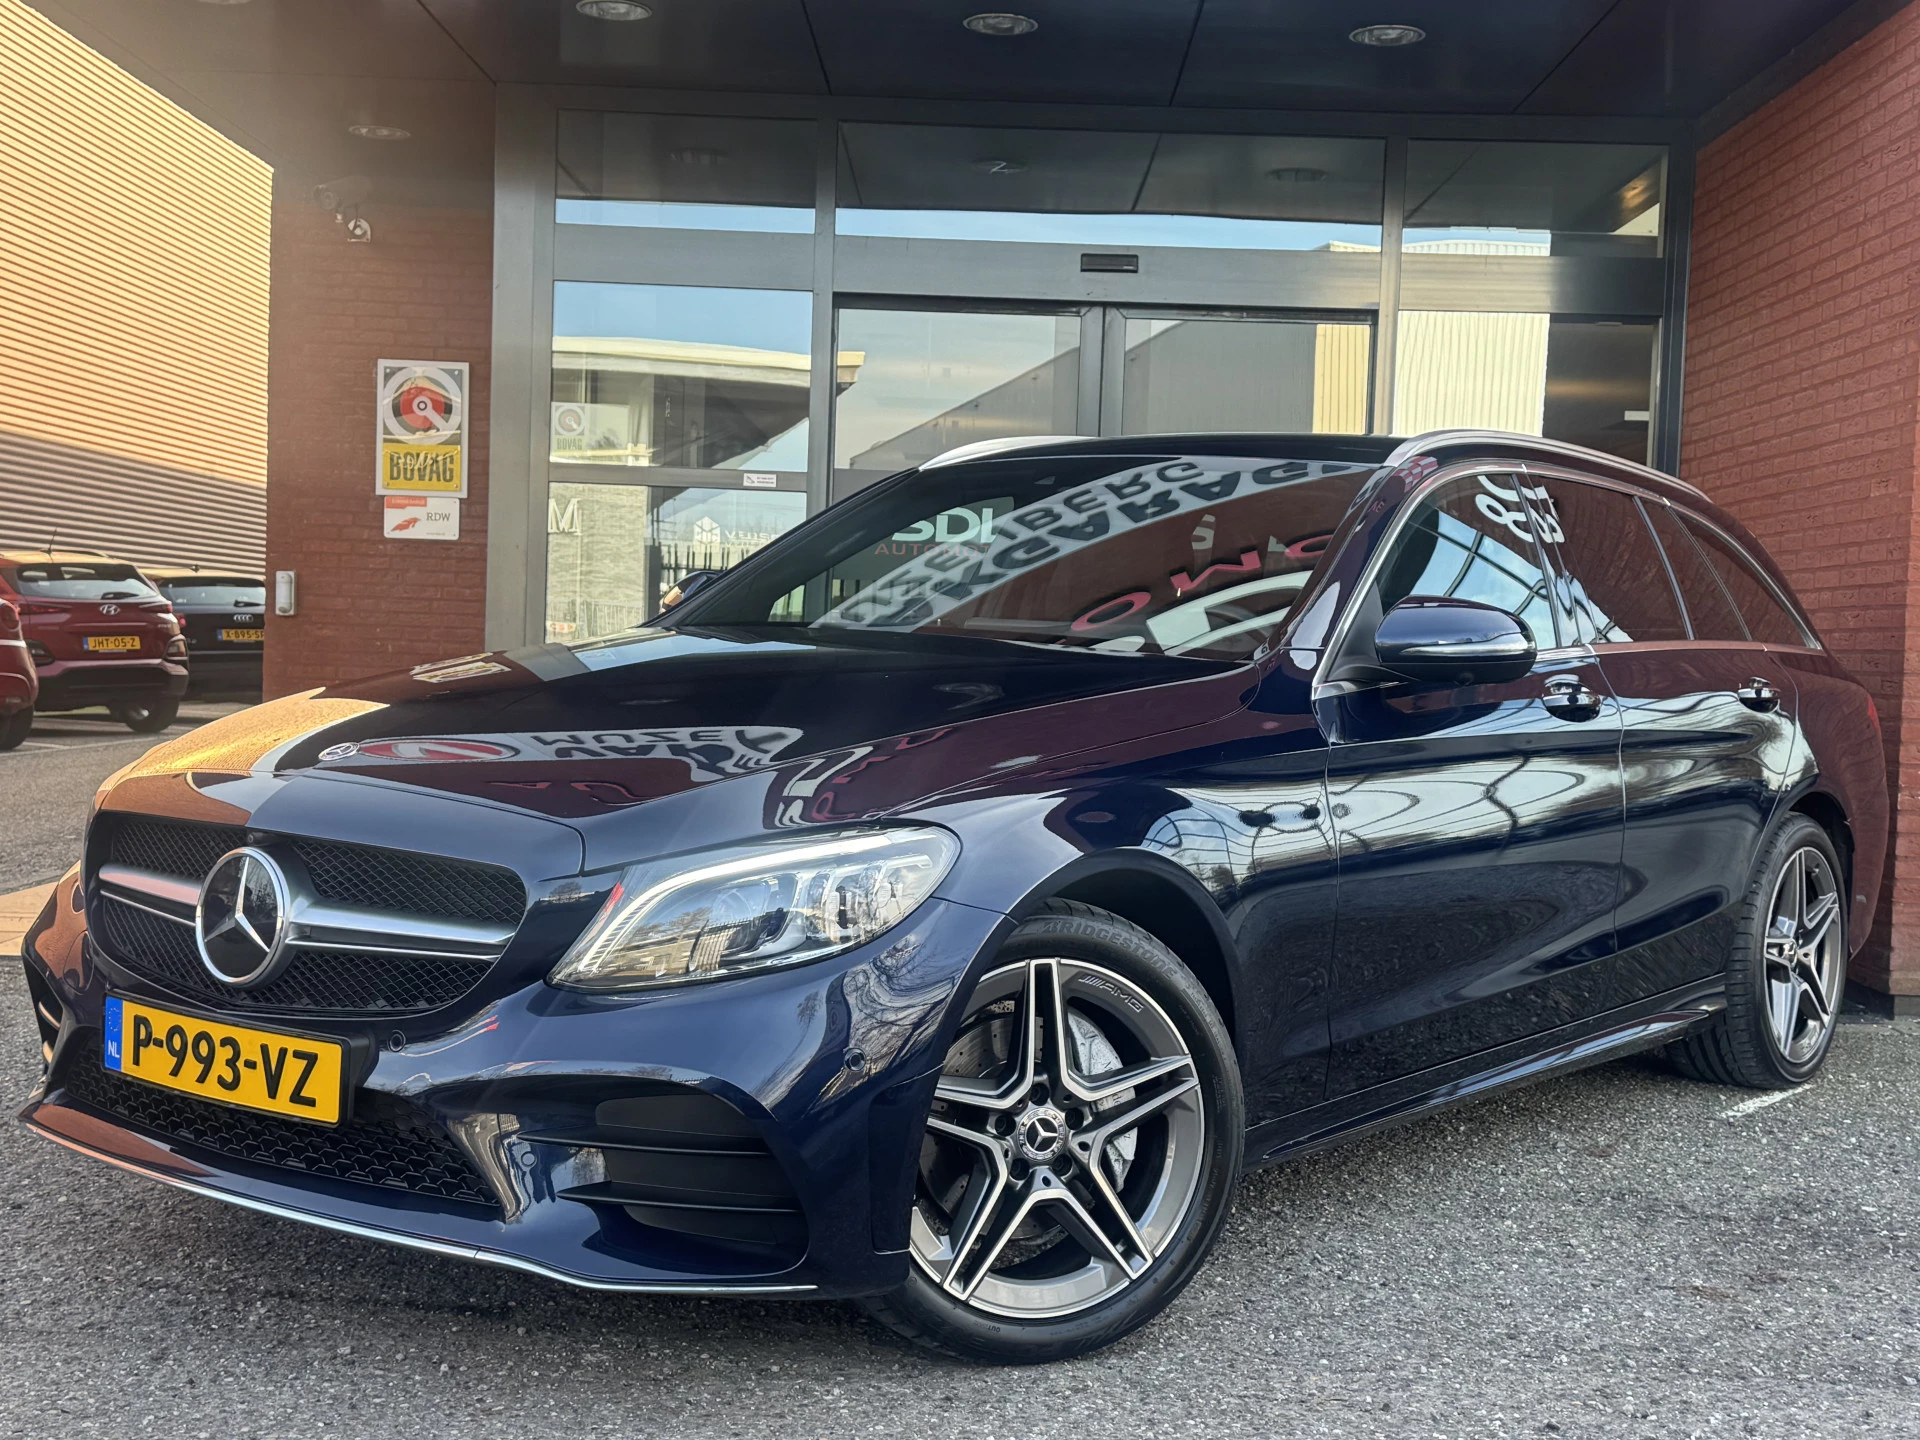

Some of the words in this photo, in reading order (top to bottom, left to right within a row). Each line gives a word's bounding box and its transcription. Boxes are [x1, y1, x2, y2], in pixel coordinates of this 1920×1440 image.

[390, 451, 454, 483] BOVAG
[426, 512, 451, 522] RDW
[92, 637, 136, 649] JHT-05-Z
[1041, 920, 1178, 980] BRIDGESTONE
[1097, 980, 1145, 1014] AMG
[107, 1040, 120, 1059] NL
[133, 1014, 318, 1108] P-993-VZ
